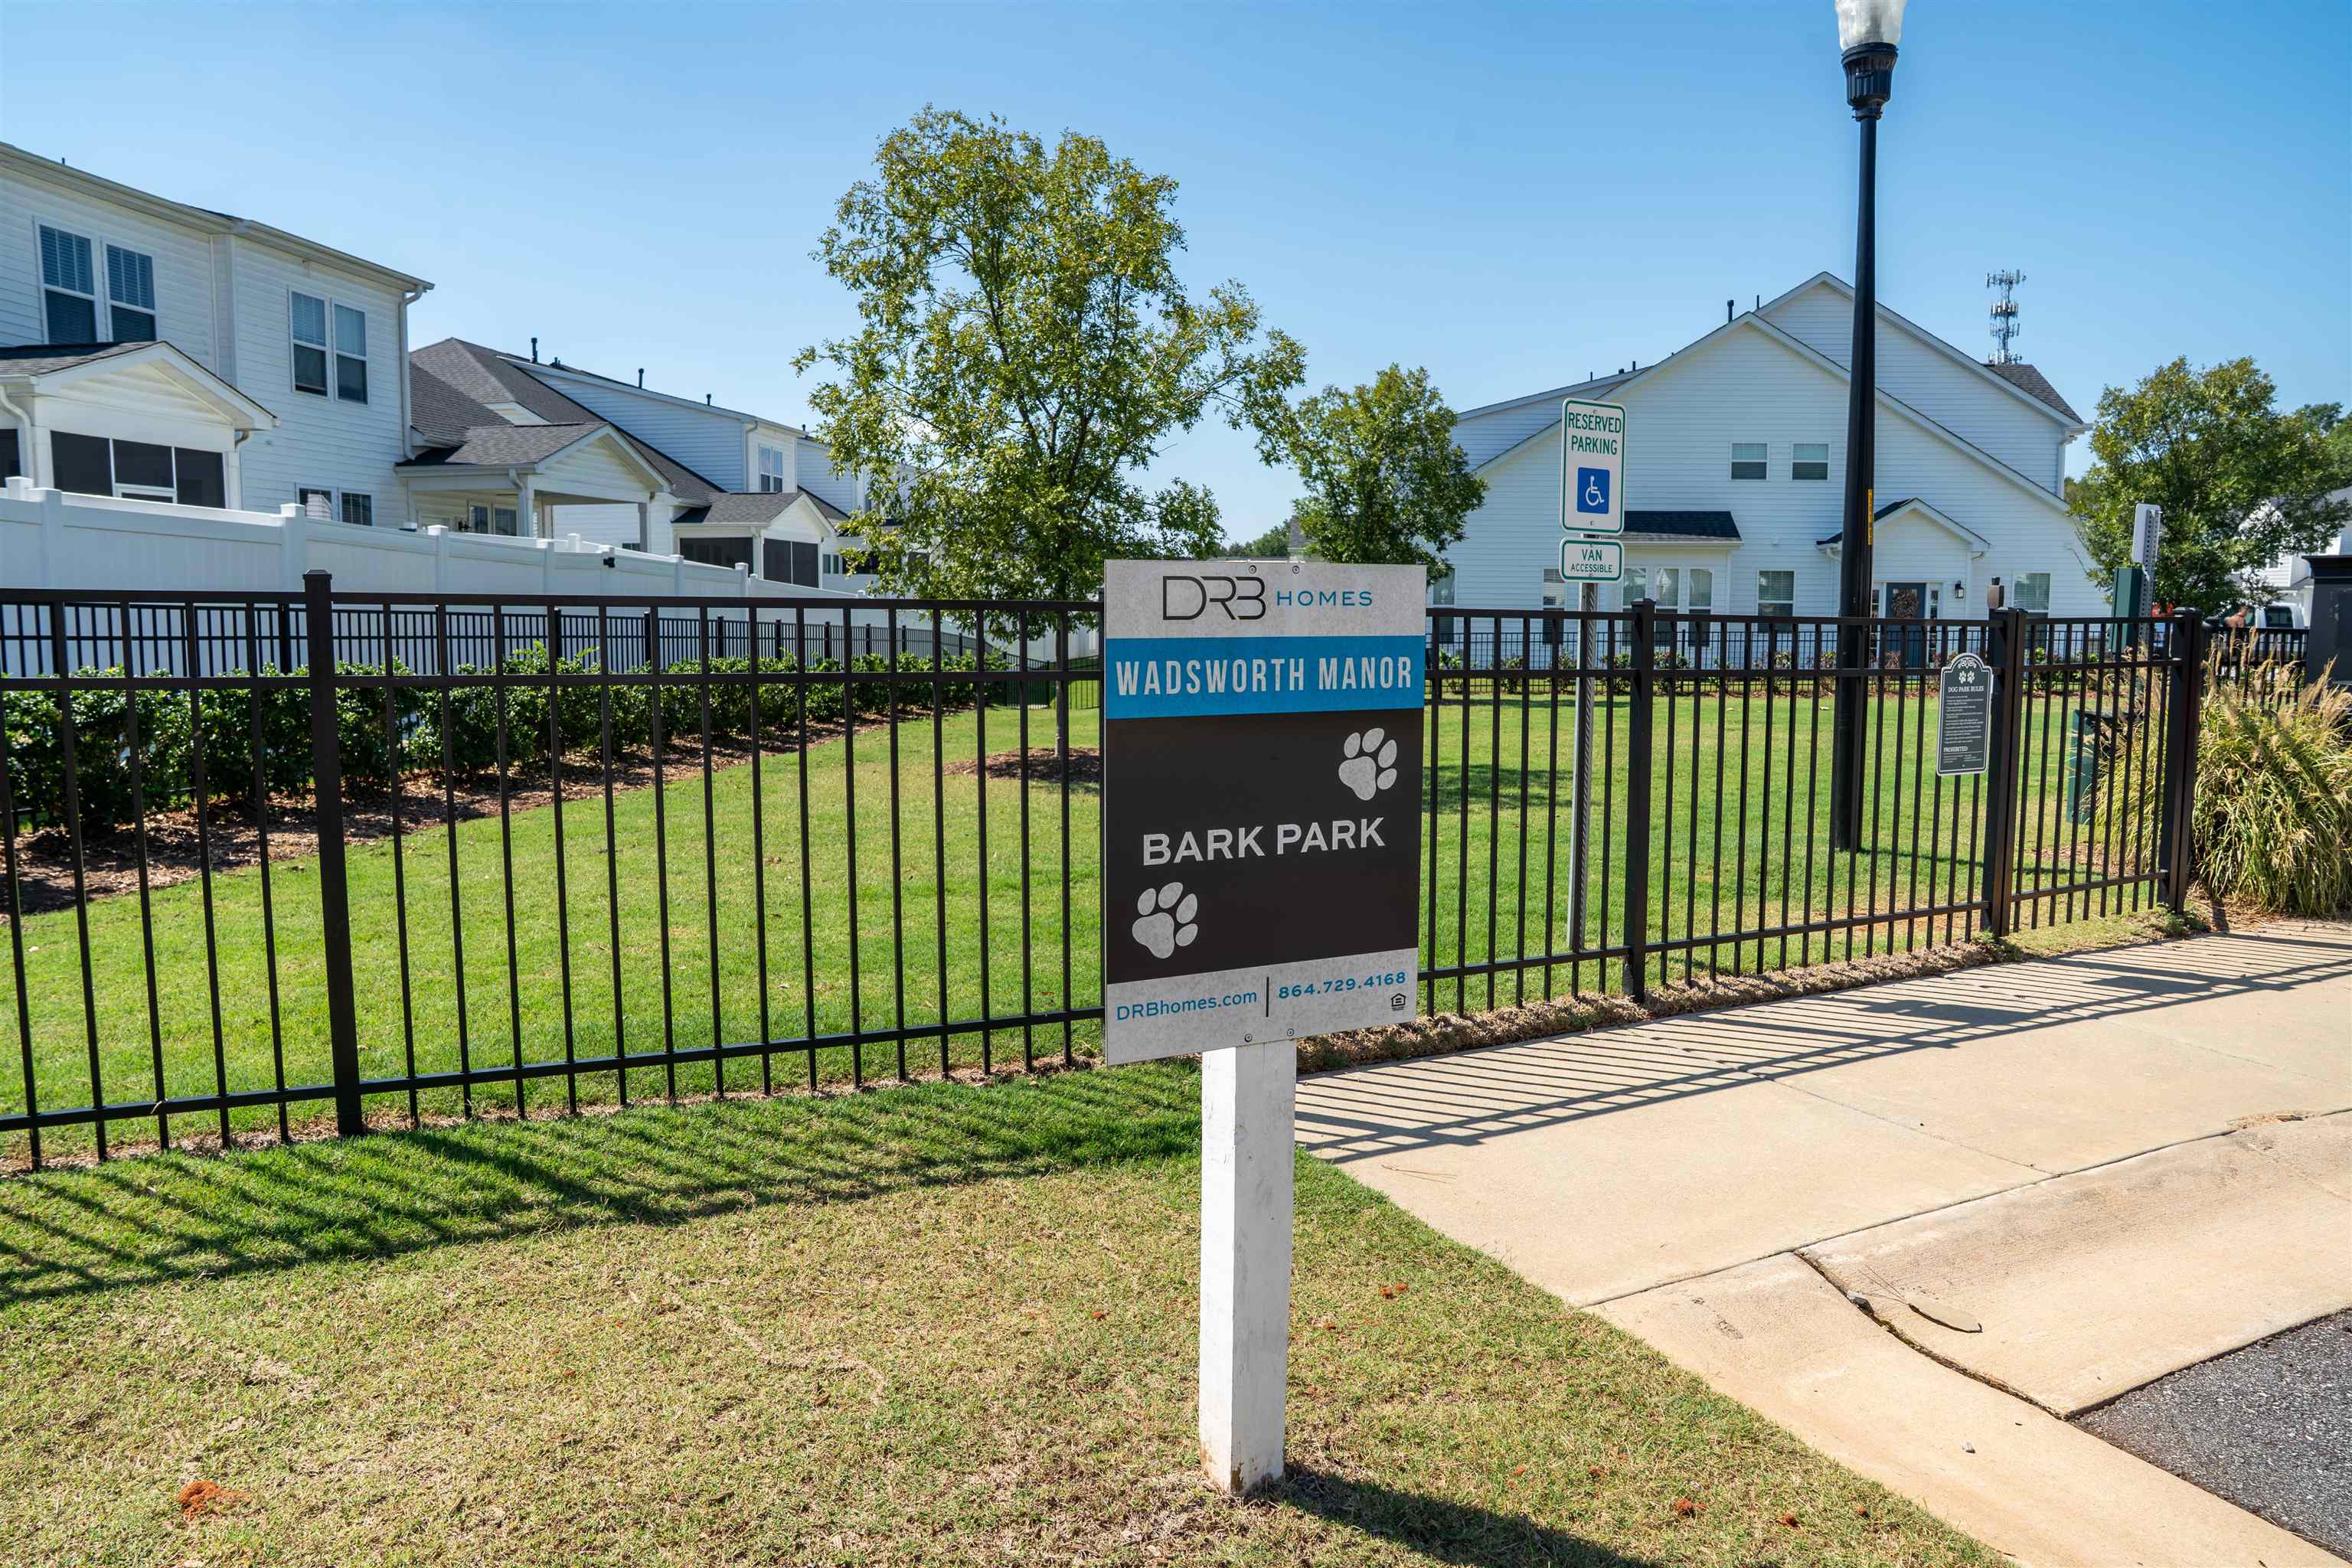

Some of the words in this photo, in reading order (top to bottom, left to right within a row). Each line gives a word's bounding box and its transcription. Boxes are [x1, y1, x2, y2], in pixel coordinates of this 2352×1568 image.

[1568, 412, 1622, 433] RESERVED
[1571, 435, 1618, 456] PARKING
[1570, 563, 1612, 573] ACCESSIBLE
[1582, 548, 1602, 561] VAN
[1162, 575, 1266, 621] DRB
[1276, 590, 1373, 606] HOMES
[1116, 658, 1305, 696] WADSWORTH
[1318, 657, 1412, 691] MANOR
[1142, 825, 1266, 866] BARK
[1276, 817, 1387, 855] PARK
[1116, 991, 1258, 1021] DRBhomes.com
[1278, 972, 1406, 1000] 864.729.4168
